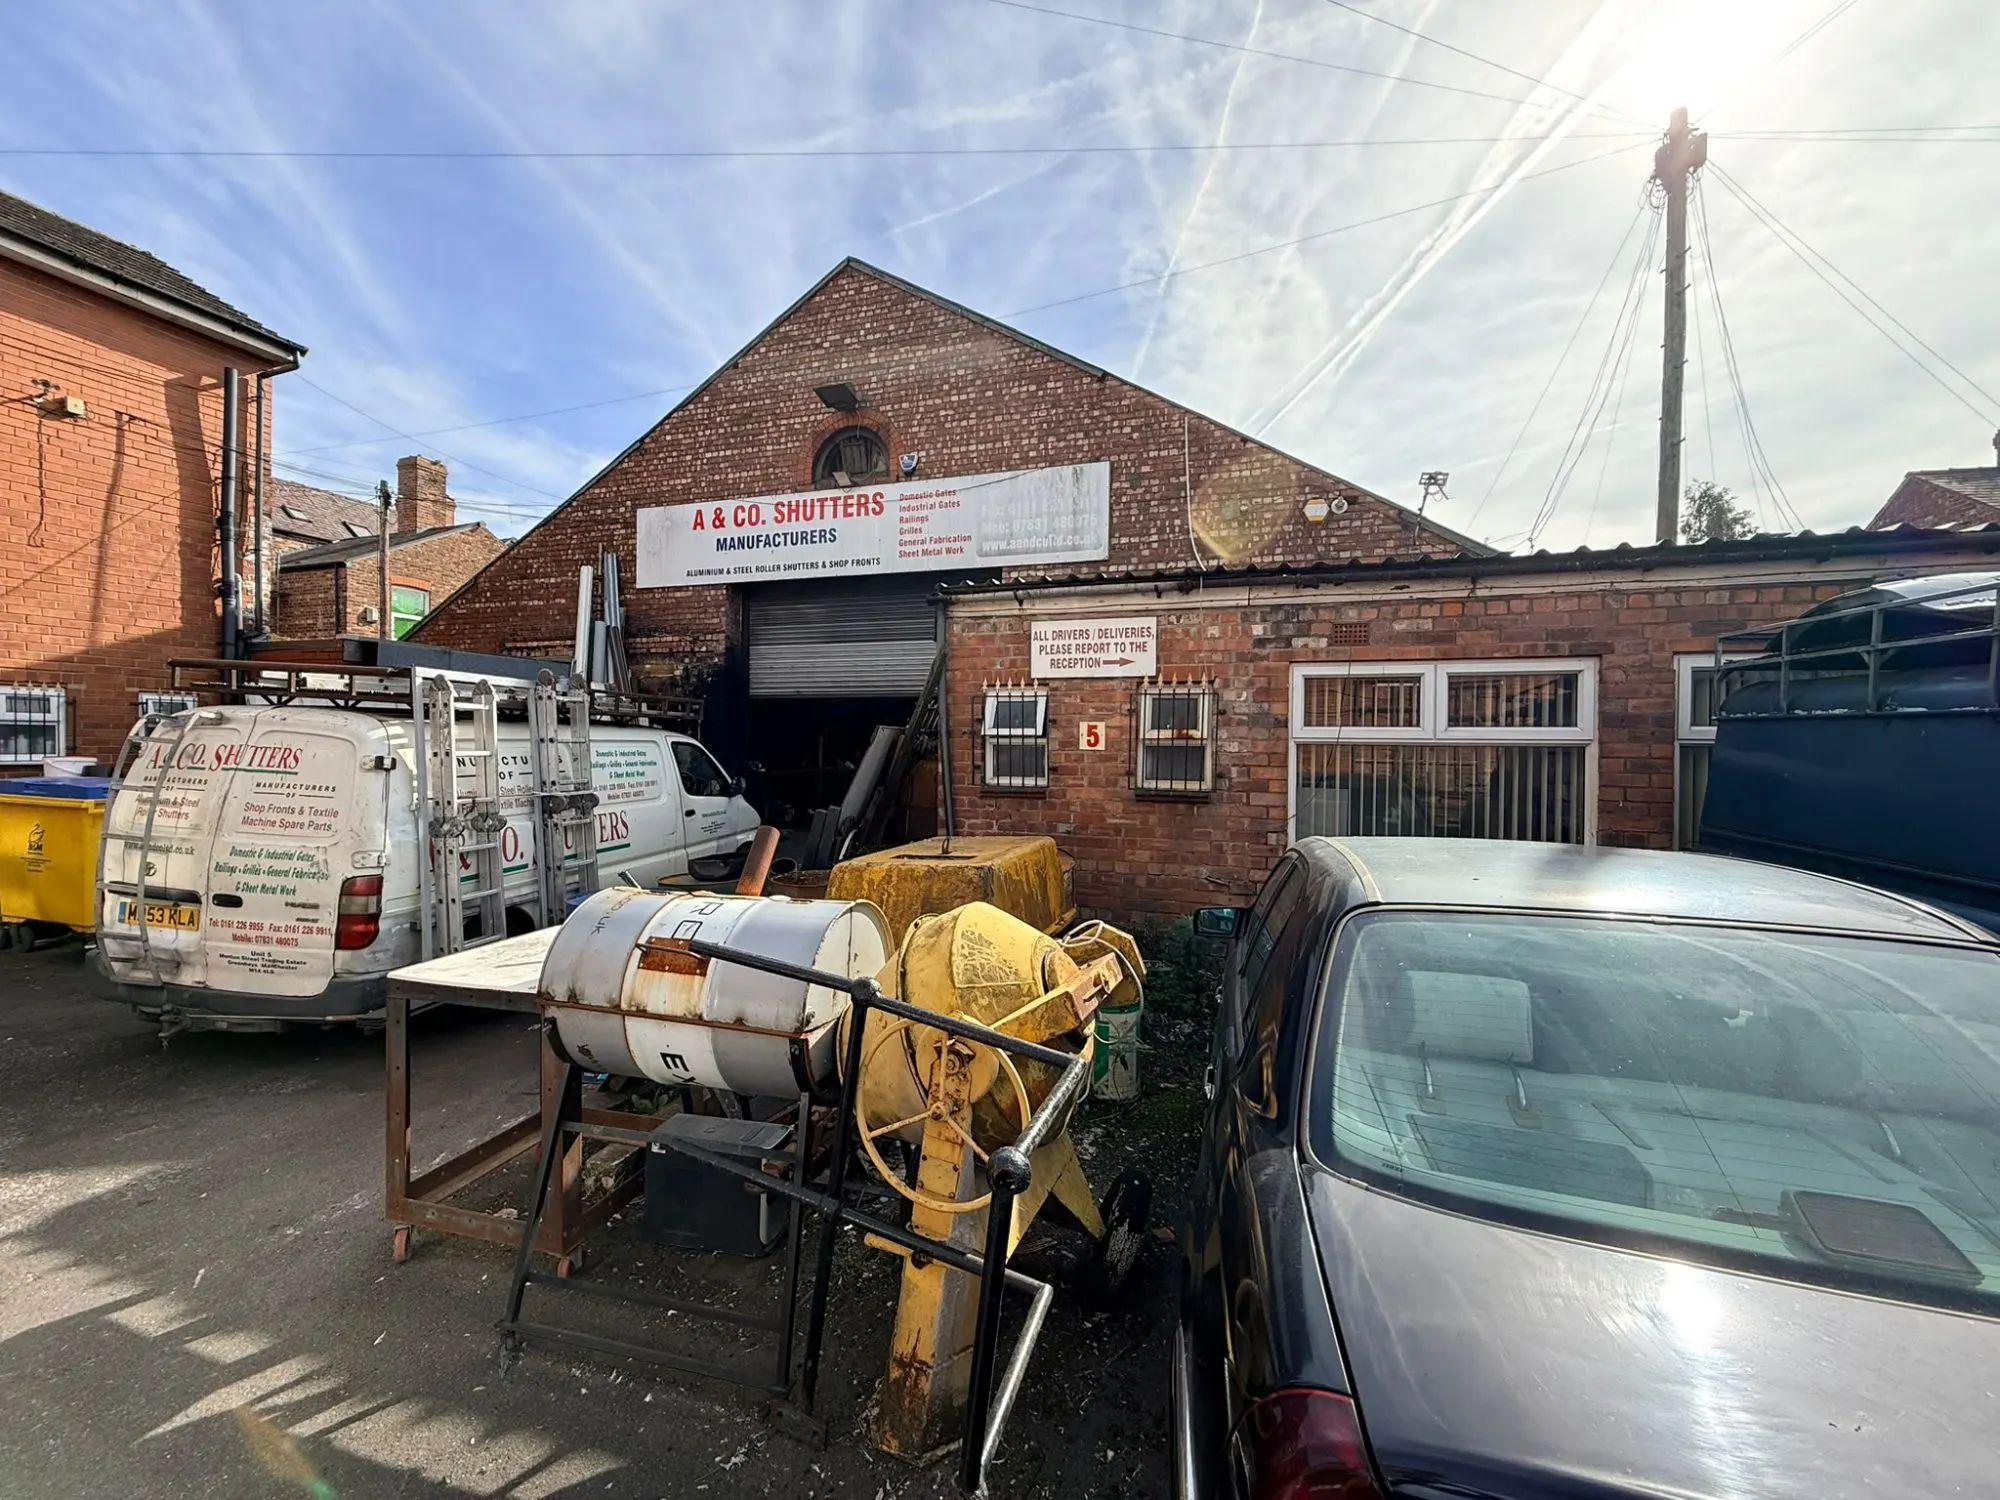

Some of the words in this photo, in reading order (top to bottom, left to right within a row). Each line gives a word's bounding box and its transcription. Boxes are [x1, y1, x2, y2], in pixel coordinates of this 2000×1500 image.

[899, 491, 933, 501] Domestic
[935, 488, 957, 498] Gates
[693, 509, 705, 530] A
[712, 507, 725, 529] &
[734, 503, 766, 527] CO.
[774, 491, 885, 524] SHUTTERS
[899, 503, 936, 513] Industrial
[939, 499, 960, 509] Gates
[899, 515, 929, 525] Railings
[899, 527, 922, 536] Grilles
[716, 527, 837, 552] MANUFACTURERS
[898, 537, 927, 547] General
[929, 534, 972, 545] Fabrication
[898, 549, 919, 559] Sheet
[921, 547, 943, 557] Metal
[945, 545, 964, 555] Work
[686, 567, 725, 577] ALUMINIUM
[726, 567, 731, 575] &
[733, 565, 752, 575] STEEL
[755, 563, 781, 573] ROLLER
[783, 561, 819, 571] SHUTTERS
[821, 560, 827, 568] &
[829, 559, 849, 568] SHOP
[852, 557, 881, 567] FRONTS
[1033, 630, 1049, 641] ALL
[1052, 628, 1090, 641] DRIVERS
[1039, 643, 1072, 655] PLEASE
[1075, 642, 1111, 654] REPORT
[1114, 642, 1126, 653] TO
[1129, 641, 1148, 653] THE
[1050, 657, 1101, 669] RECEPTION
[1086, 724, 1100, 747] 5
[146, 744, 161, 769] A
[499, 771, 513, 780] OF
[255, 782, 336, 793] MANUFACTURERS
[244, 802, 265, 814] Shop
[267, 803, 295, 816] Fronts
[298, 806, 304, 816] &
[308, 806, 339, 818] Textile
[241, 816, 277, 828] Machine
[279, 818, 305, 831] Spare
[502, 826, 524, 862] O.
[229, 846, 257, 859] Domestic
[264, 848, 295, 860] Industrial
[267, 866, 291, 878] General
[128, 904, 165, 923] M53
[168, 908, 195, 927] KLA
